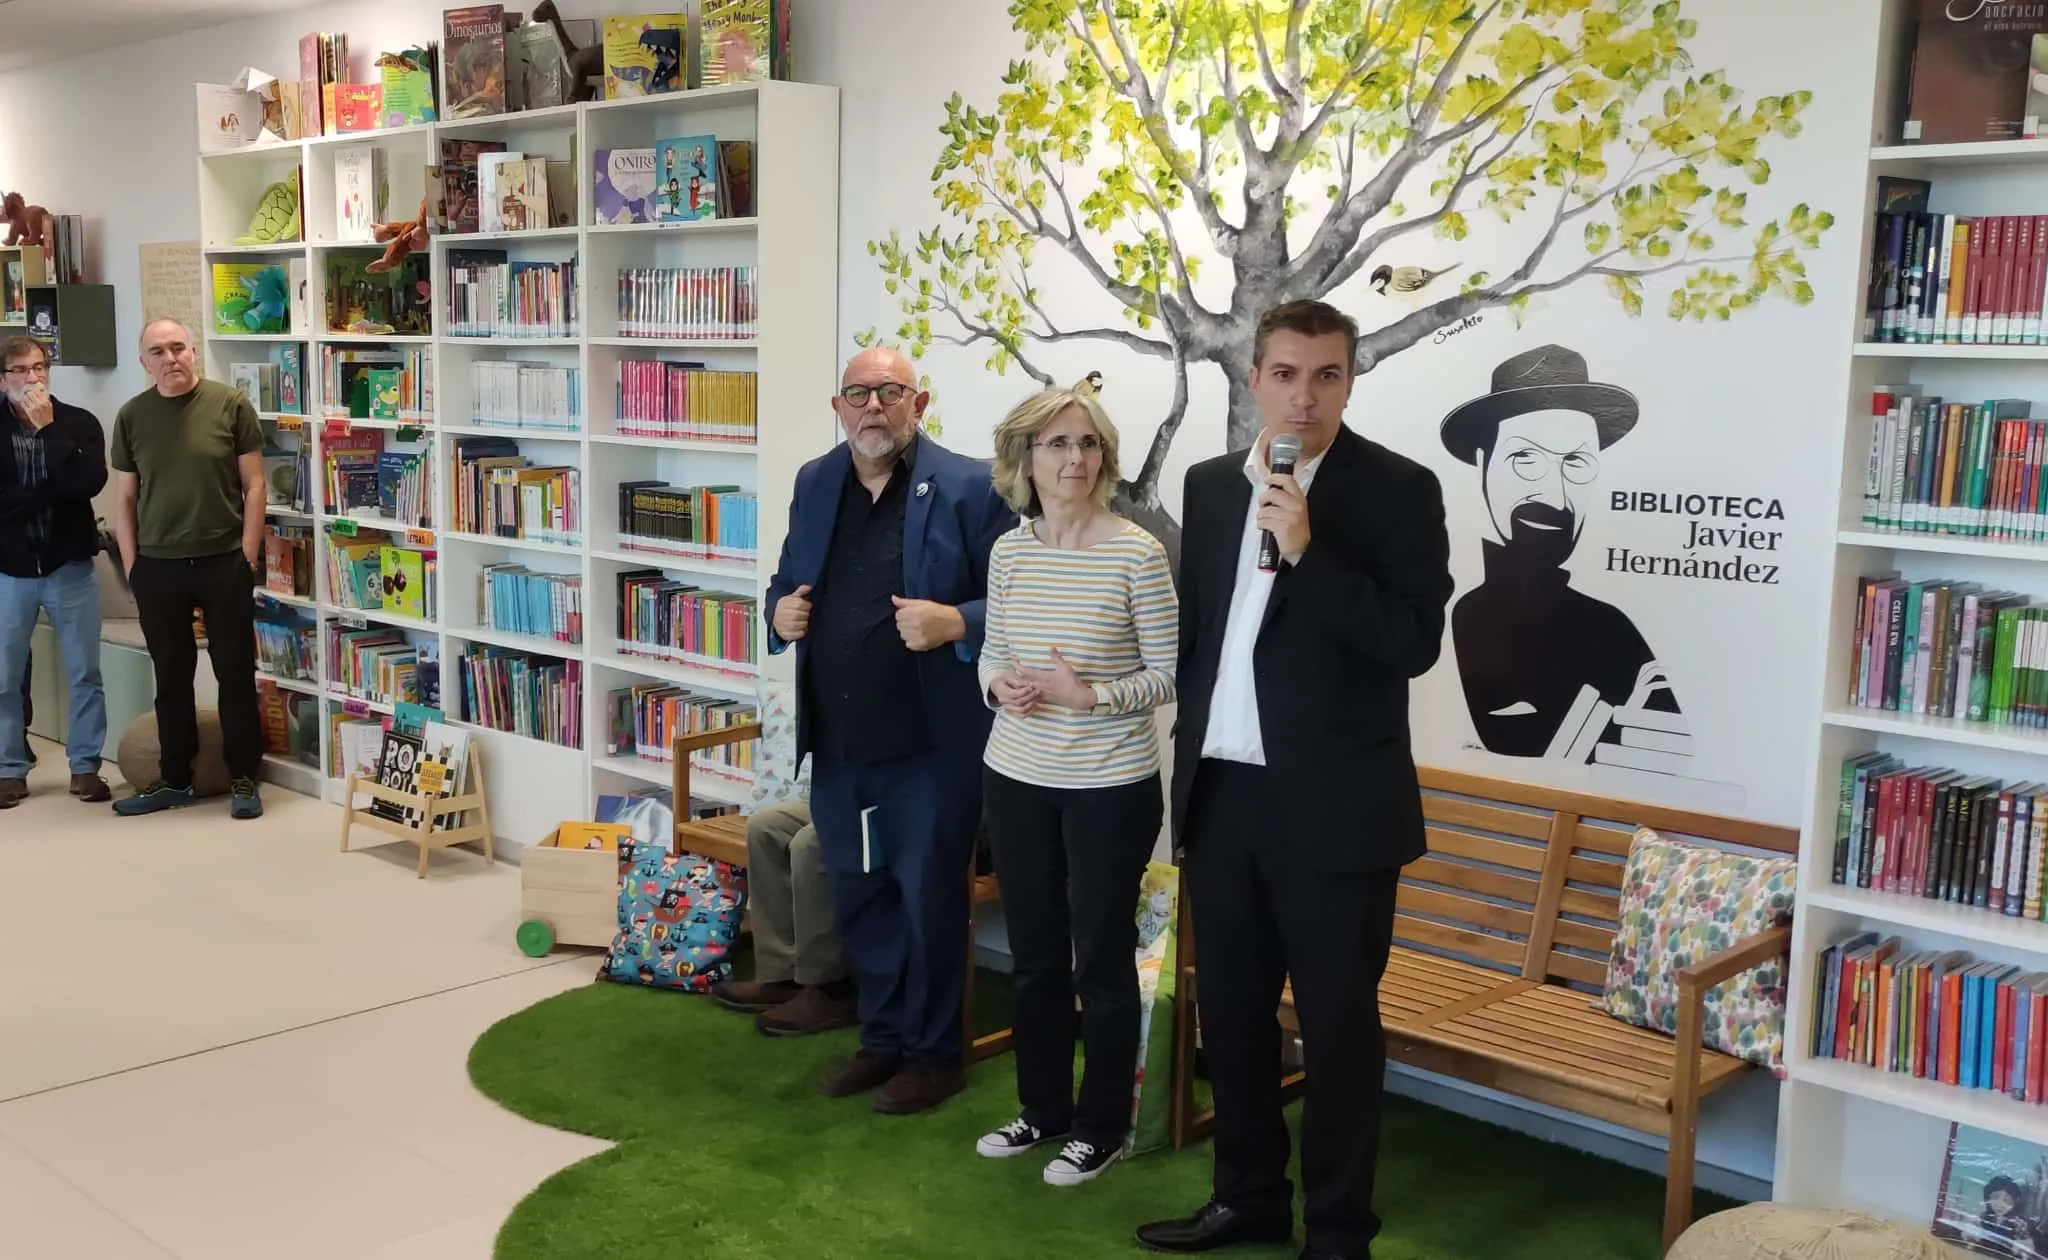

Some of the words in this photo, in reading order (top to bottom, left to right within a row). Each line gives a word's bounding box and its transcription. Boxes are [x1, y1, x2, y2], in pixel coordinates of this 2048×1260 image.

[445, 22, 502, 40] Dinosaurios
[1610, 490, 1785, 520] BIBLIOTECA
[1682, 520, 1783, 550] Javier
[1605, 547, 1780, 585] Hernández
